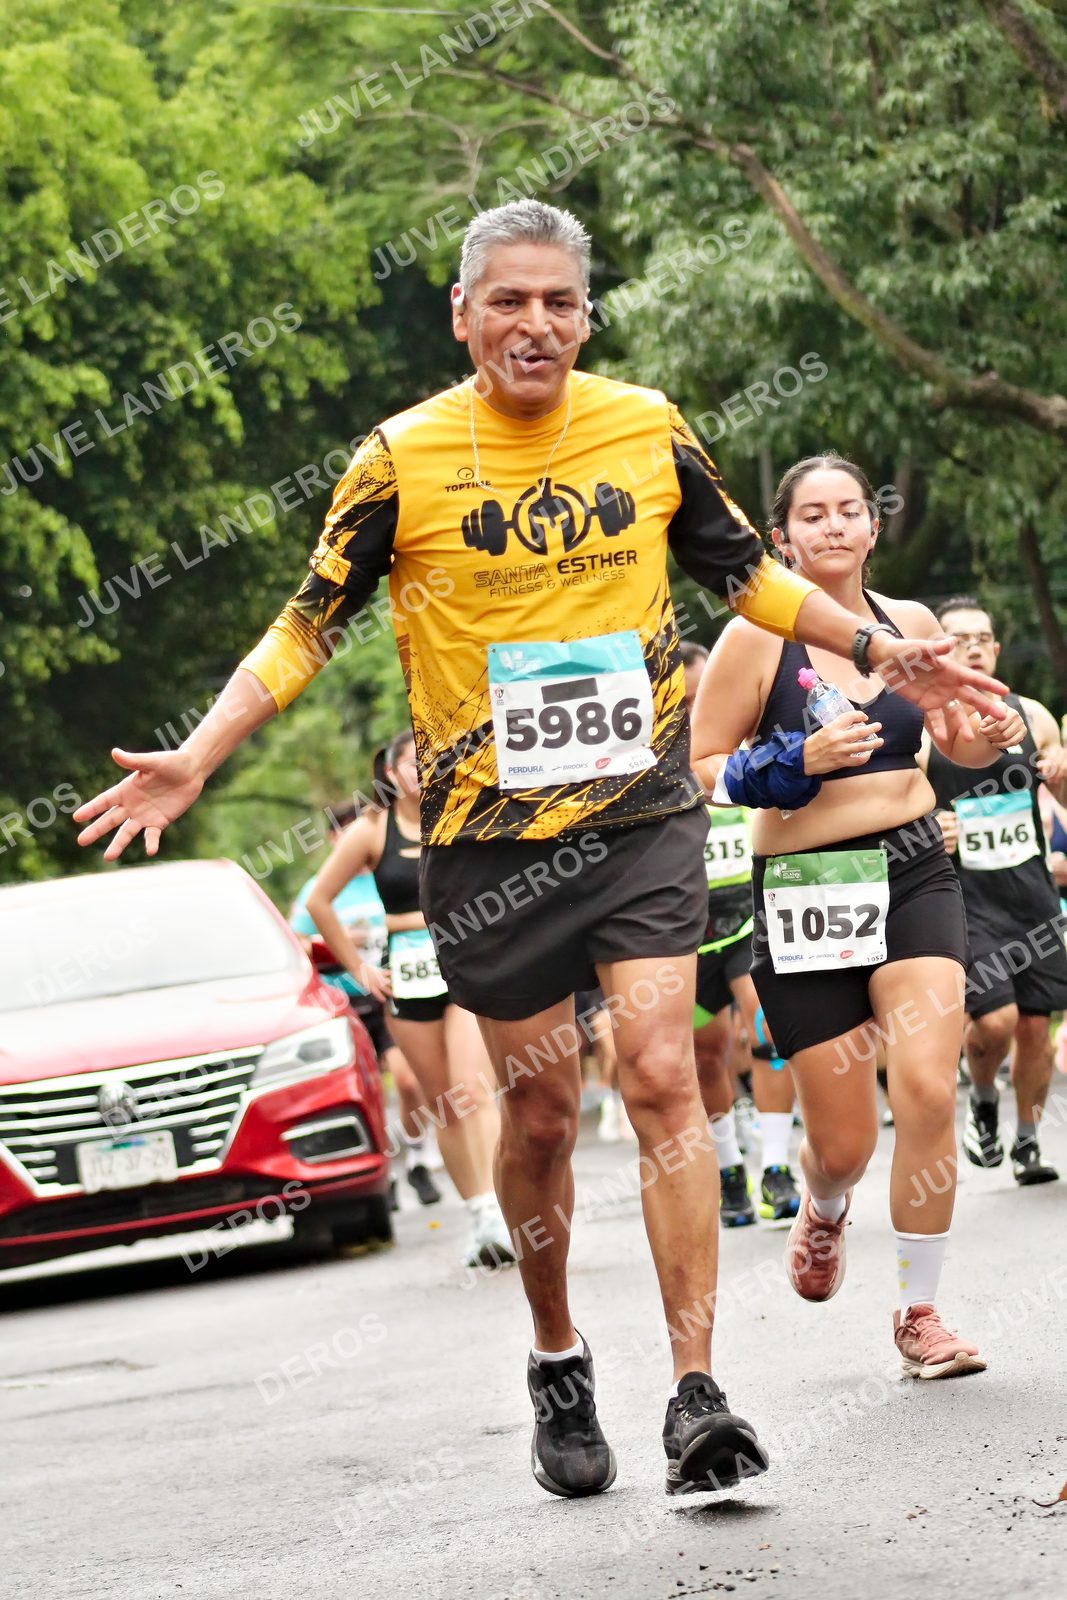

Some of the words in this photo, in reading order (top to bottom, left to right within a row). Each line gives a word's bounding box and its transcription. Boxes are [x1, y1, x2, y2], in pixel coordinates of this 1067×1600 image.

[474, 563, 550, 589] SANTA
[557, 550, 638, 575] ESTHER
[490, 584, 543, 598] FITNESS
[546, 580, 557, 591] &
[560, 569, 626, 587] WELLNESS
[506, 697, 643, 752] 5986
[508, 765, 545, 775] PERDURA
[965, 823, 1029, 852] 5146
[776, 903, 880, 944] 1052
